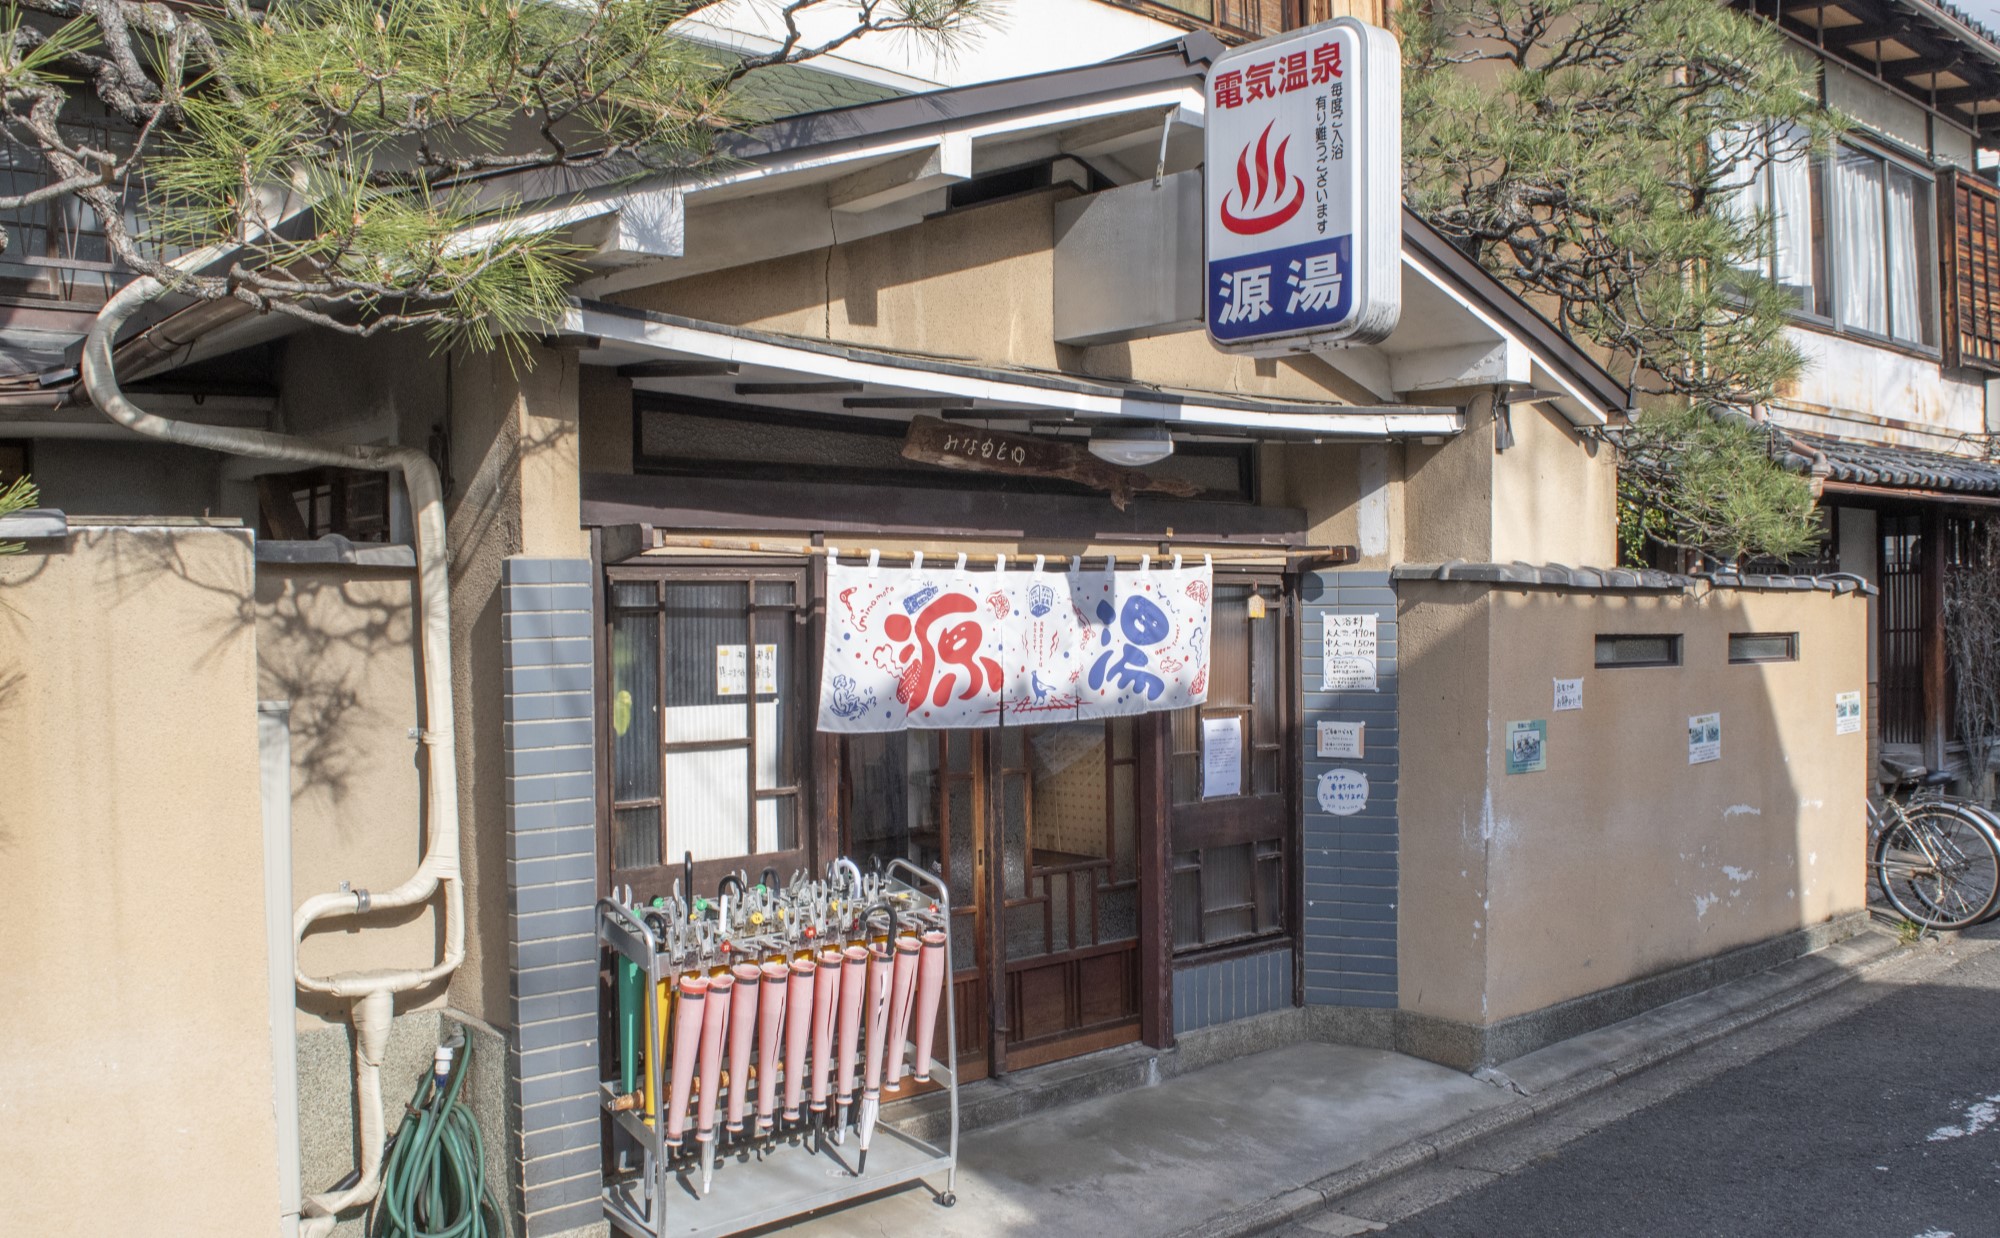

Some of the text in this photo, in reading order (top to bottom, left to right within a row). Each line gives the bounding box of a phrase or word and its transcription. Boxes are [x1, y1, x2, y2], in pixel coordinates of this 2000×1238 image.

[1214, 42, 1343, 109] 電気温泉
[1330, 81, 1344, 161] 毎度ご入浴
[1315, 95, 1328, 235] 有り難うございます
[1217, 252, 1343, 326] 源湯
